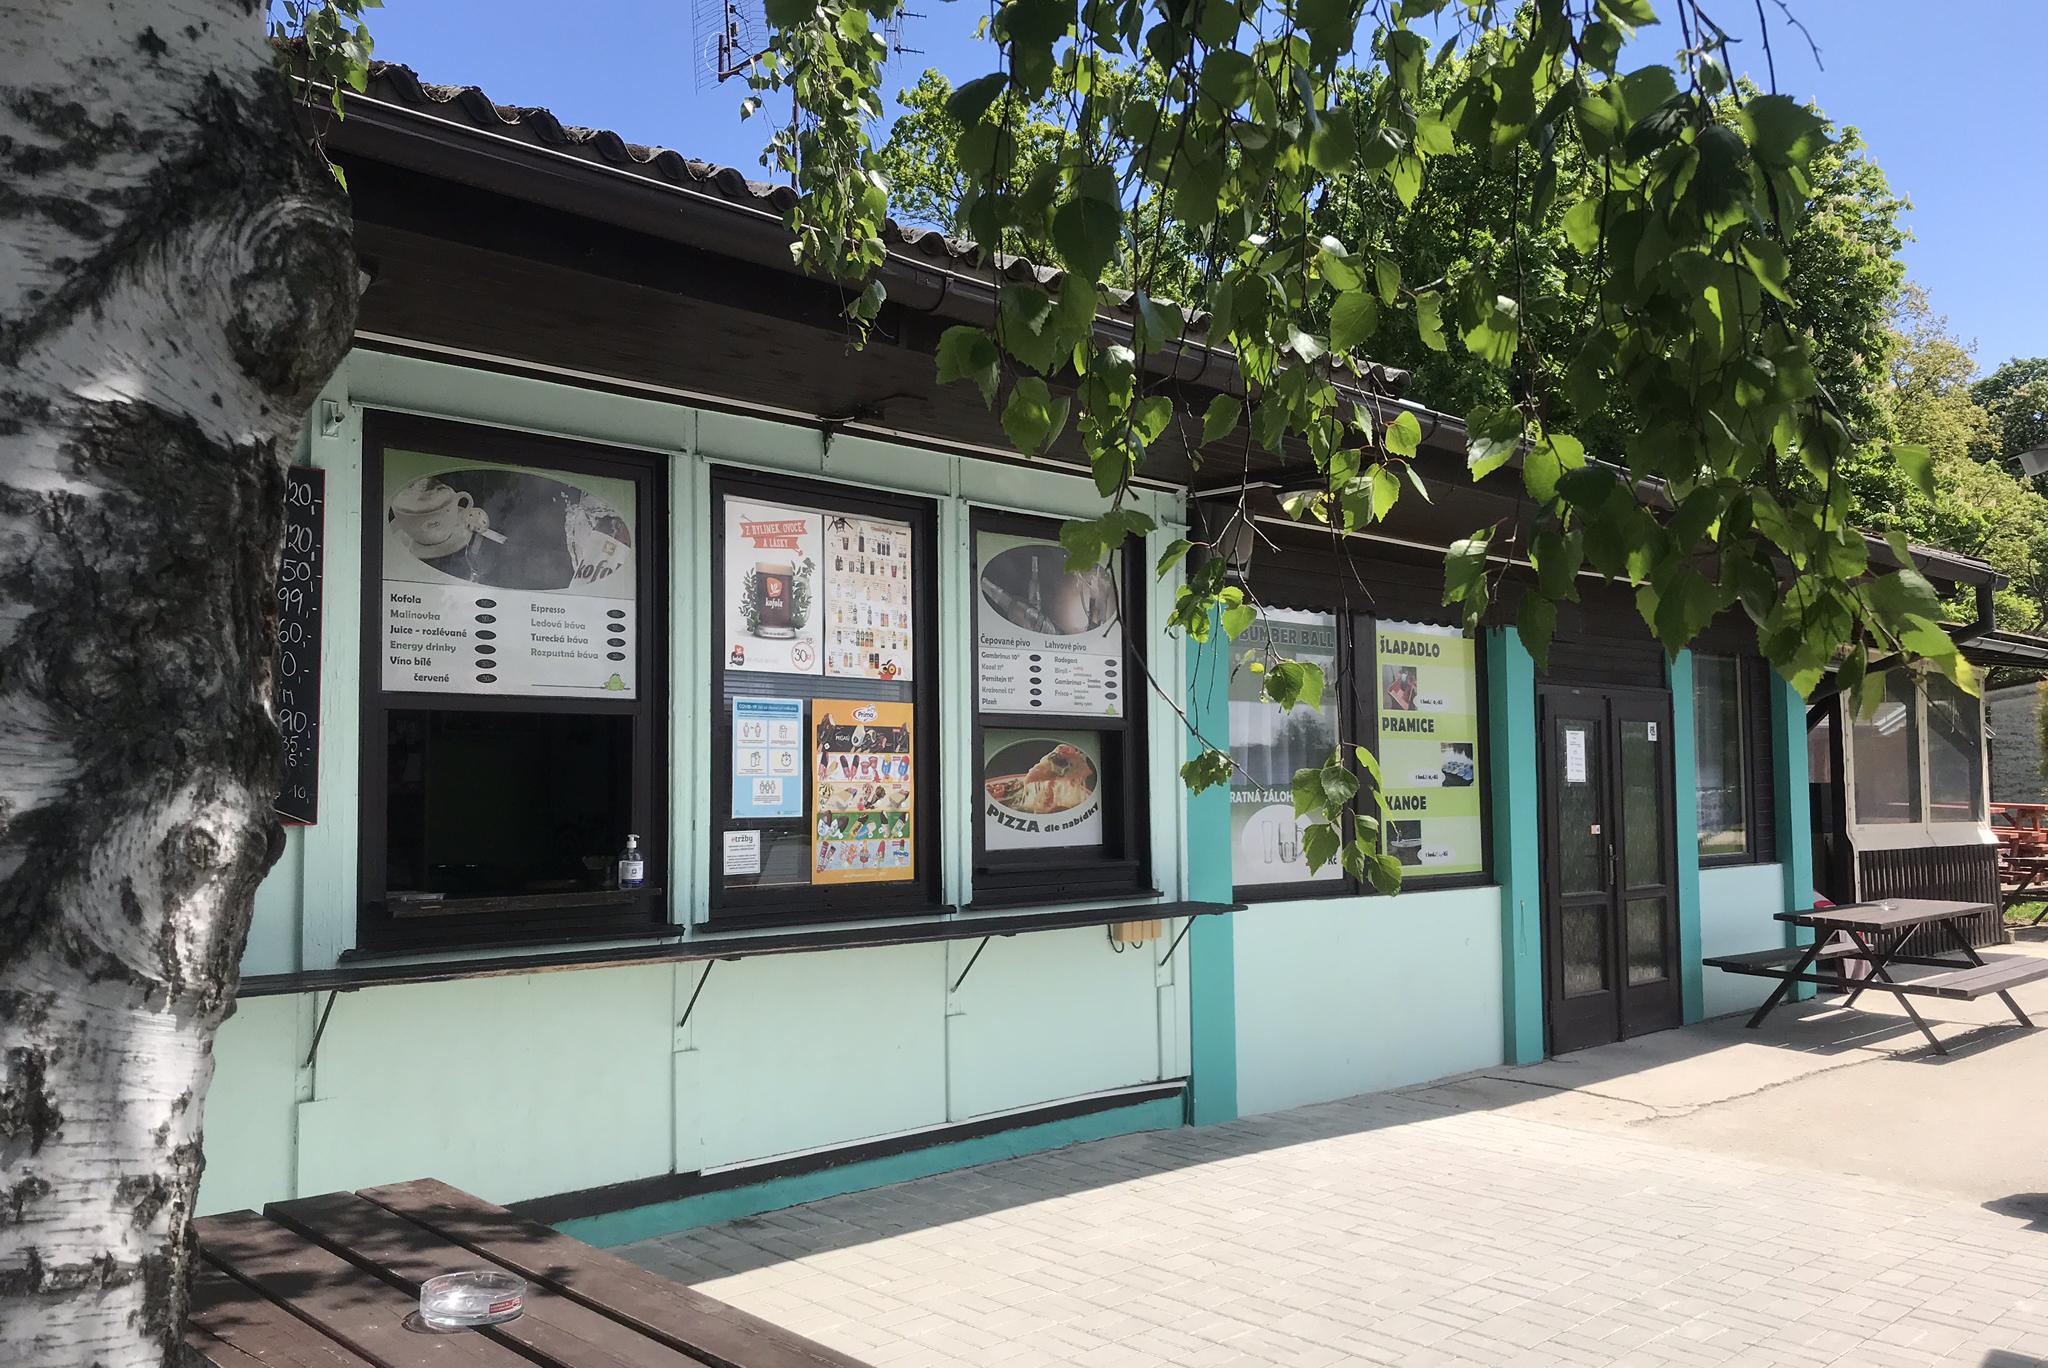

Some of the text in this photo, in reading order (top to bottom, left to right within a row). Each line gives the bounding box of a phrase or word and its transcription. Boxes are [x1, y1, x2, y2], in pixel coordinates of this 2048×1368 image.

[390, 593, 421, 604] Kofola
[765, 598, 784, 609] kofola
[390, 609, 441, 621] Malinovka
[531, 604, 566, 615] Espresso
[531, 618, 586, 630] Ledová káva
[390, 625, 413, 635] Juice
[422, 627, 467, 638] rozlévané
[531, 633, 589, 645] Turecká káva
[980, 633, 1031, 648] Čepované pivo
[1301, 629, 1335, 648] BALL
[390, 640, 457, 653] Energy drinky
[1044, 640, 1087, 652] Lahvové pivo
[1380, 635, 1440, 658] ŠLAPADLO
[530, 648, 575, 659] Rozpustná
[577, 650, 599, 660] káva
[981, 651, 1011, 660] Gambrinus
[390, 656, 432, 667] Víno bílé
[413, 672, 450, 683] červené
[1382, 716, 1435, 733] PRAMICE
[1230, 788, 1294, 804] RATNÁ ZÁLOH
[1385, 795, 1427, 811] KANOE
[986, 803, 1040, 833] PIZZA
[1044, 823, 1061, 833] dle
